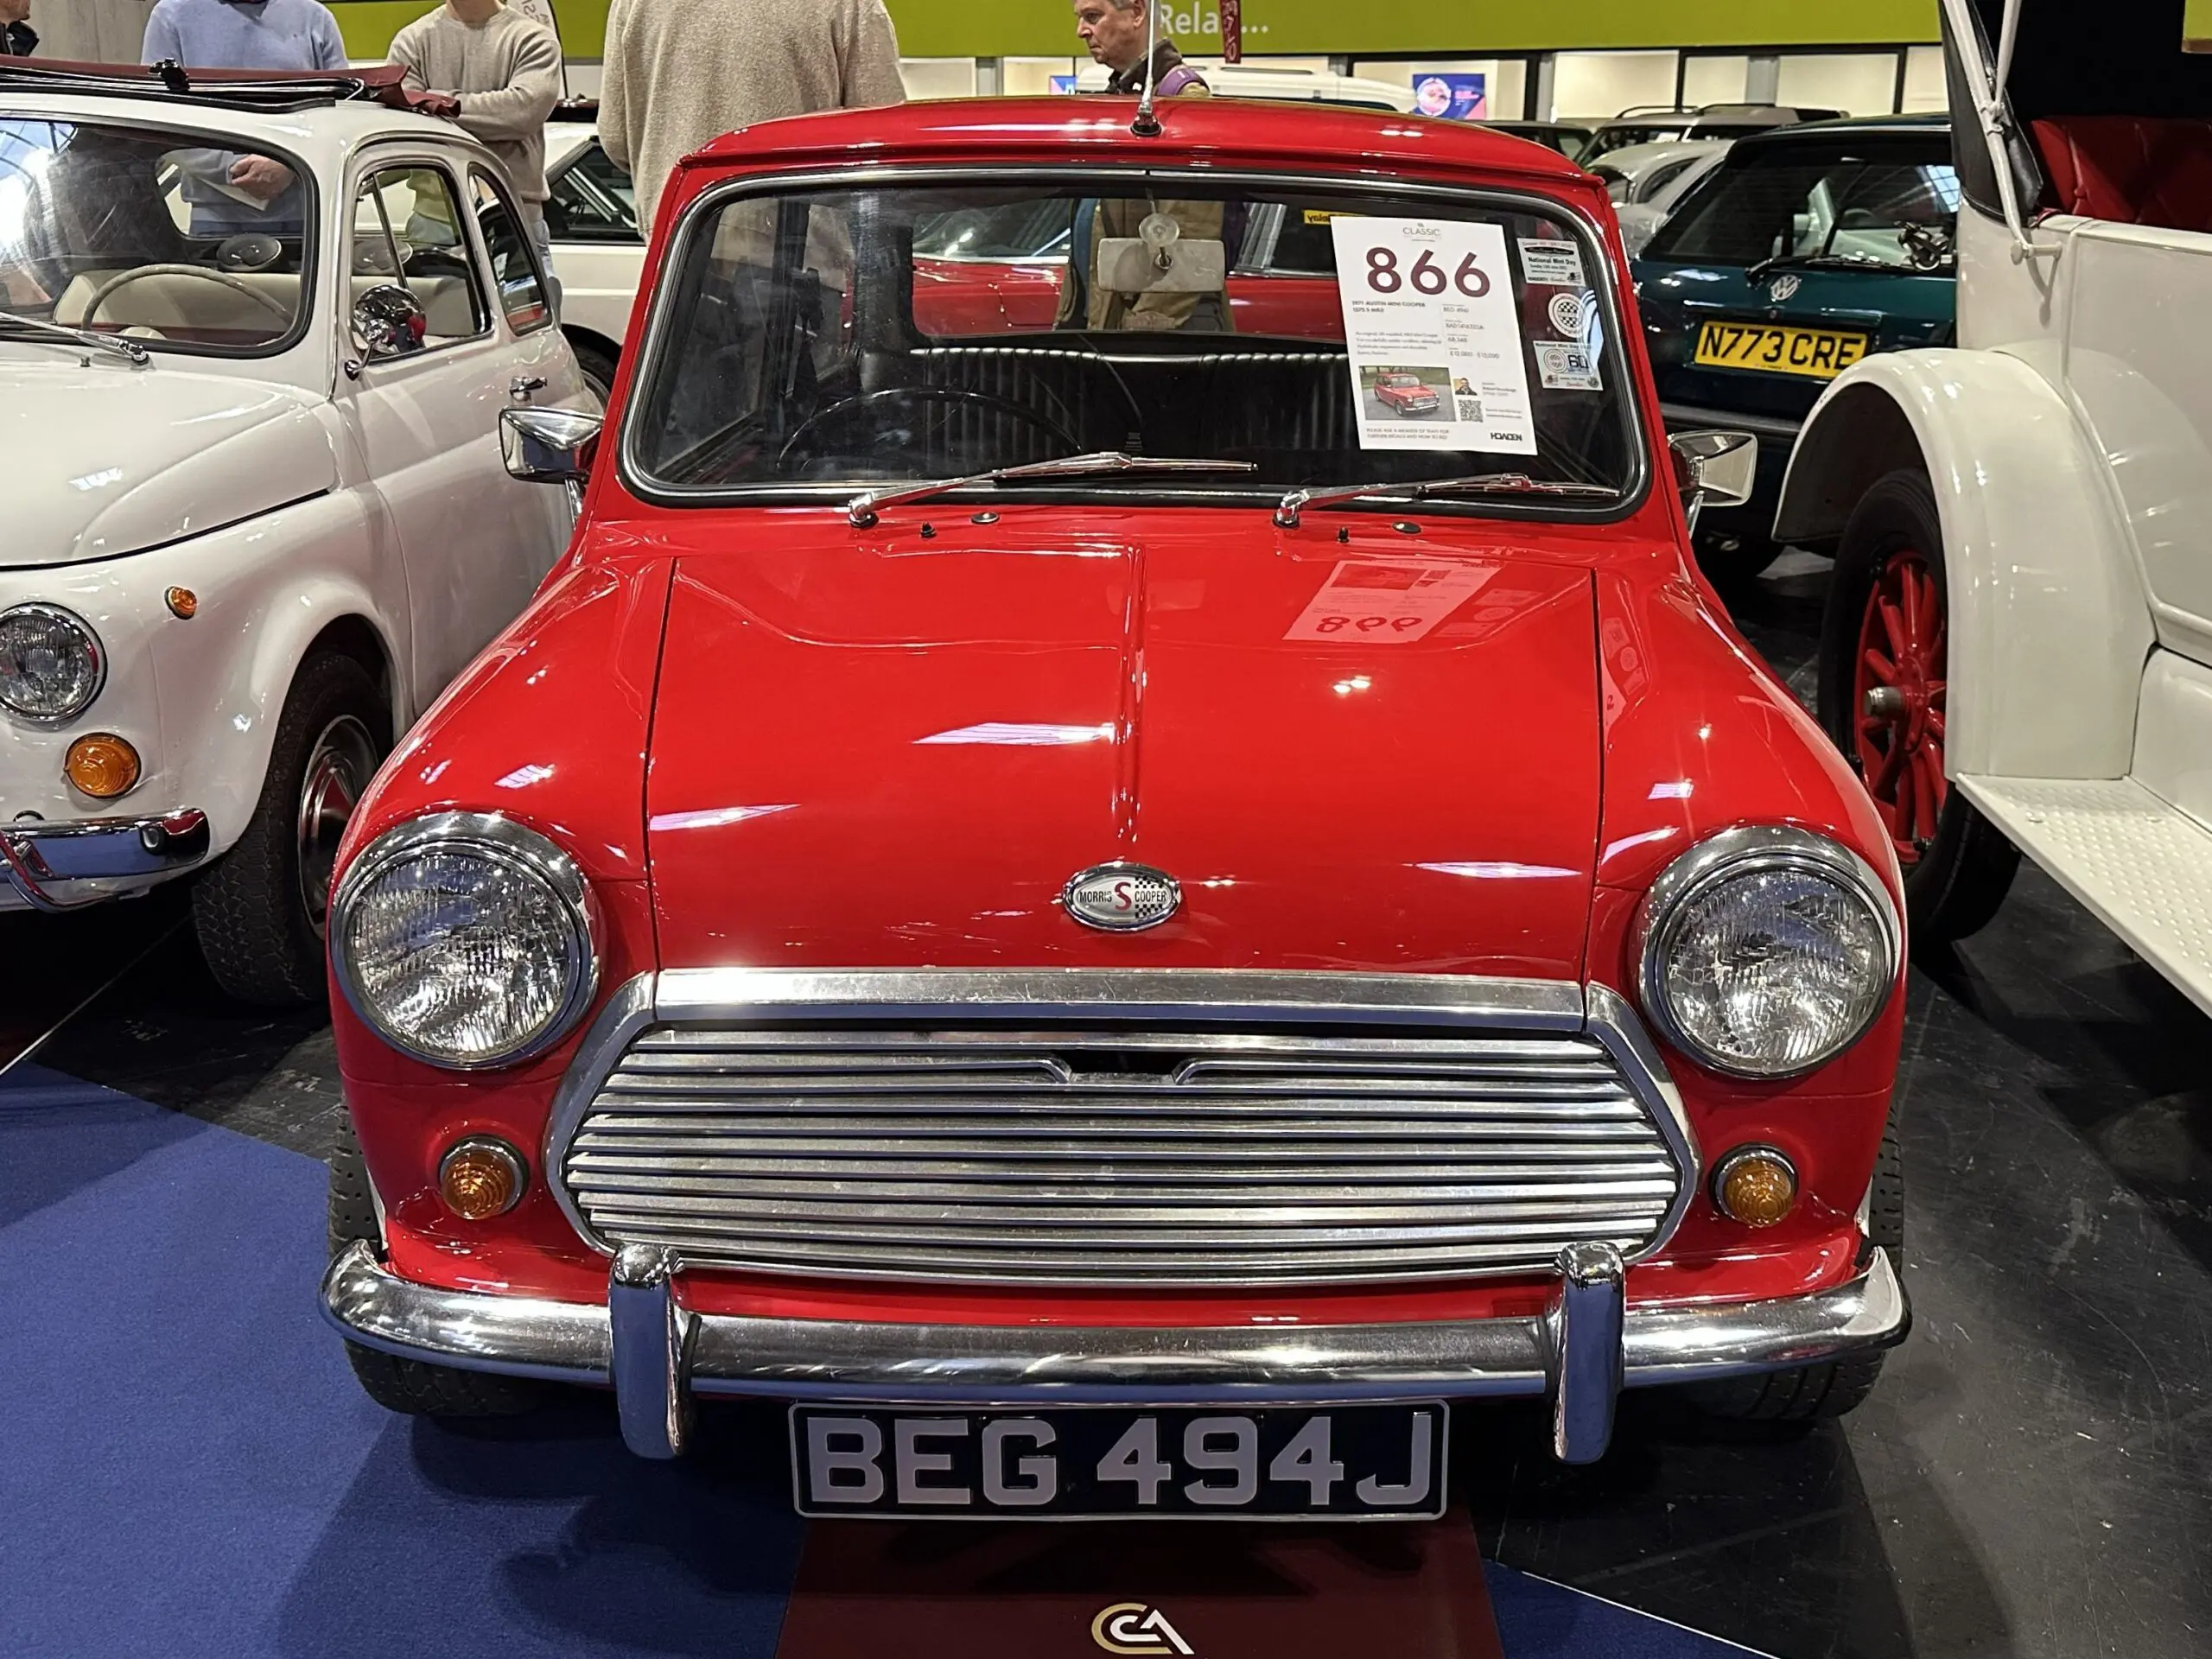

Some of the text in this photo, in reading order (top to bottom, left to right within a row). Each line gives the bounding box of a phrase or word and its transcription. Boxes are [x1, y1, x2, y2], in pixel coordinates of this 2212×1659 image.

[1160, 1, 1269, 35] Rela...
[1402, 226, 1442, 237] CLASSIC
[1366, 247, 1491, 298] 866
[1701, 325, 1862, 371] N773 CRE
[1079, 881, 1167, 911] MORRIS S COOPER
[804, 1411, 1432, 1506] BEG 494J
